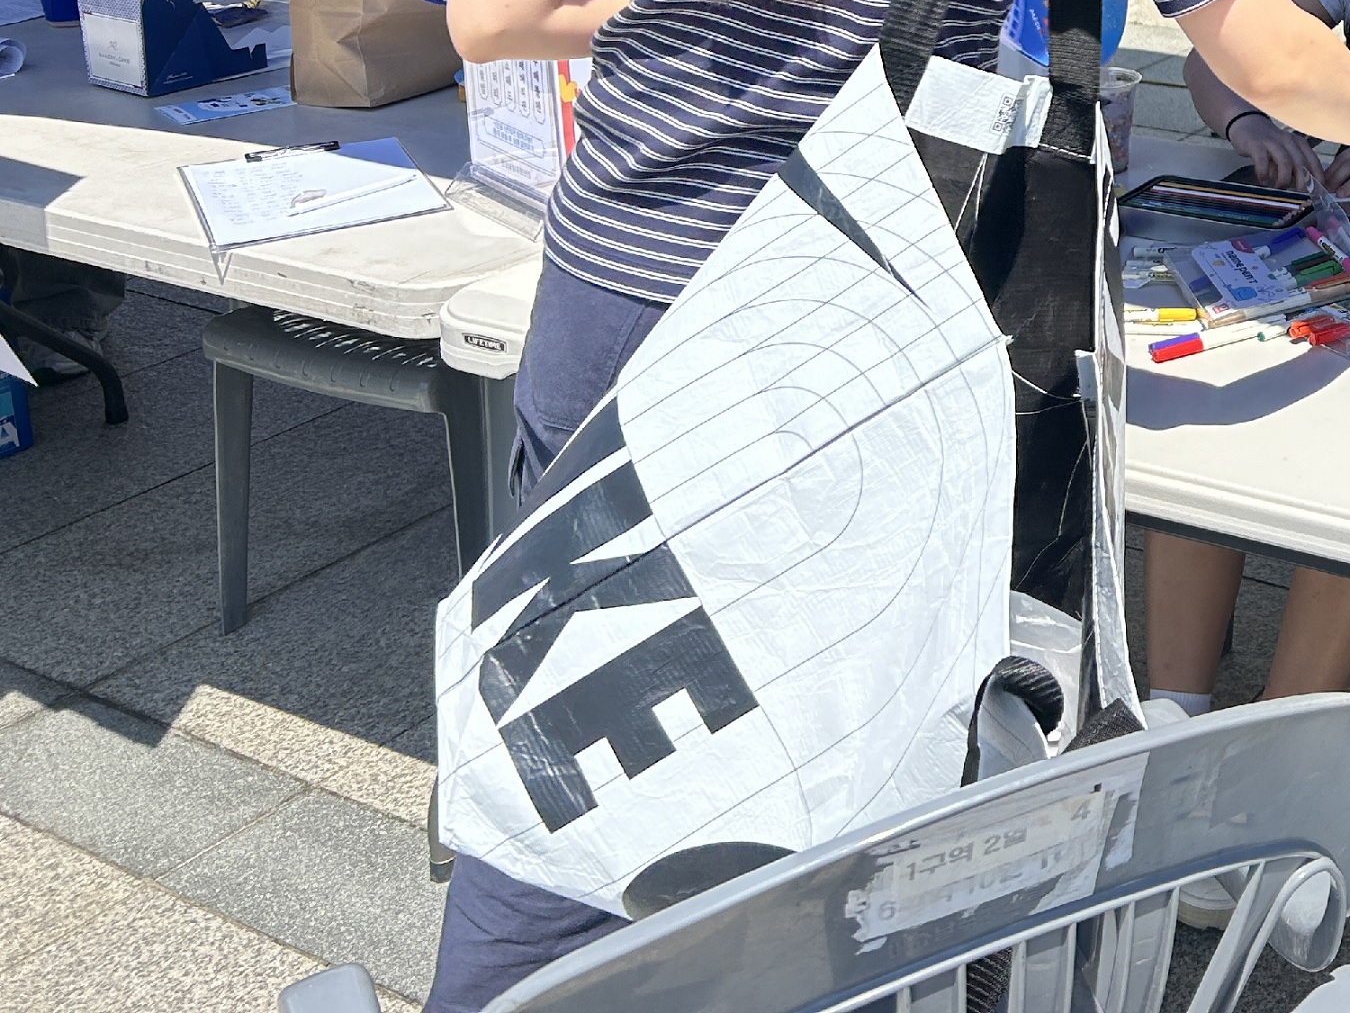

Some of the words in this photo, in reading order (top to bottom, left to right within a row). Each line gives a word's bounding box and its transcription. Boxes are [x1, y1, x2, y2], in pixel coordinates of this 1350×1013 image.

[467, 336, 503, 351] LIFETIME
[905, 840, 974, 882] 1구역
[1070, 801, 1092, 821] 4
